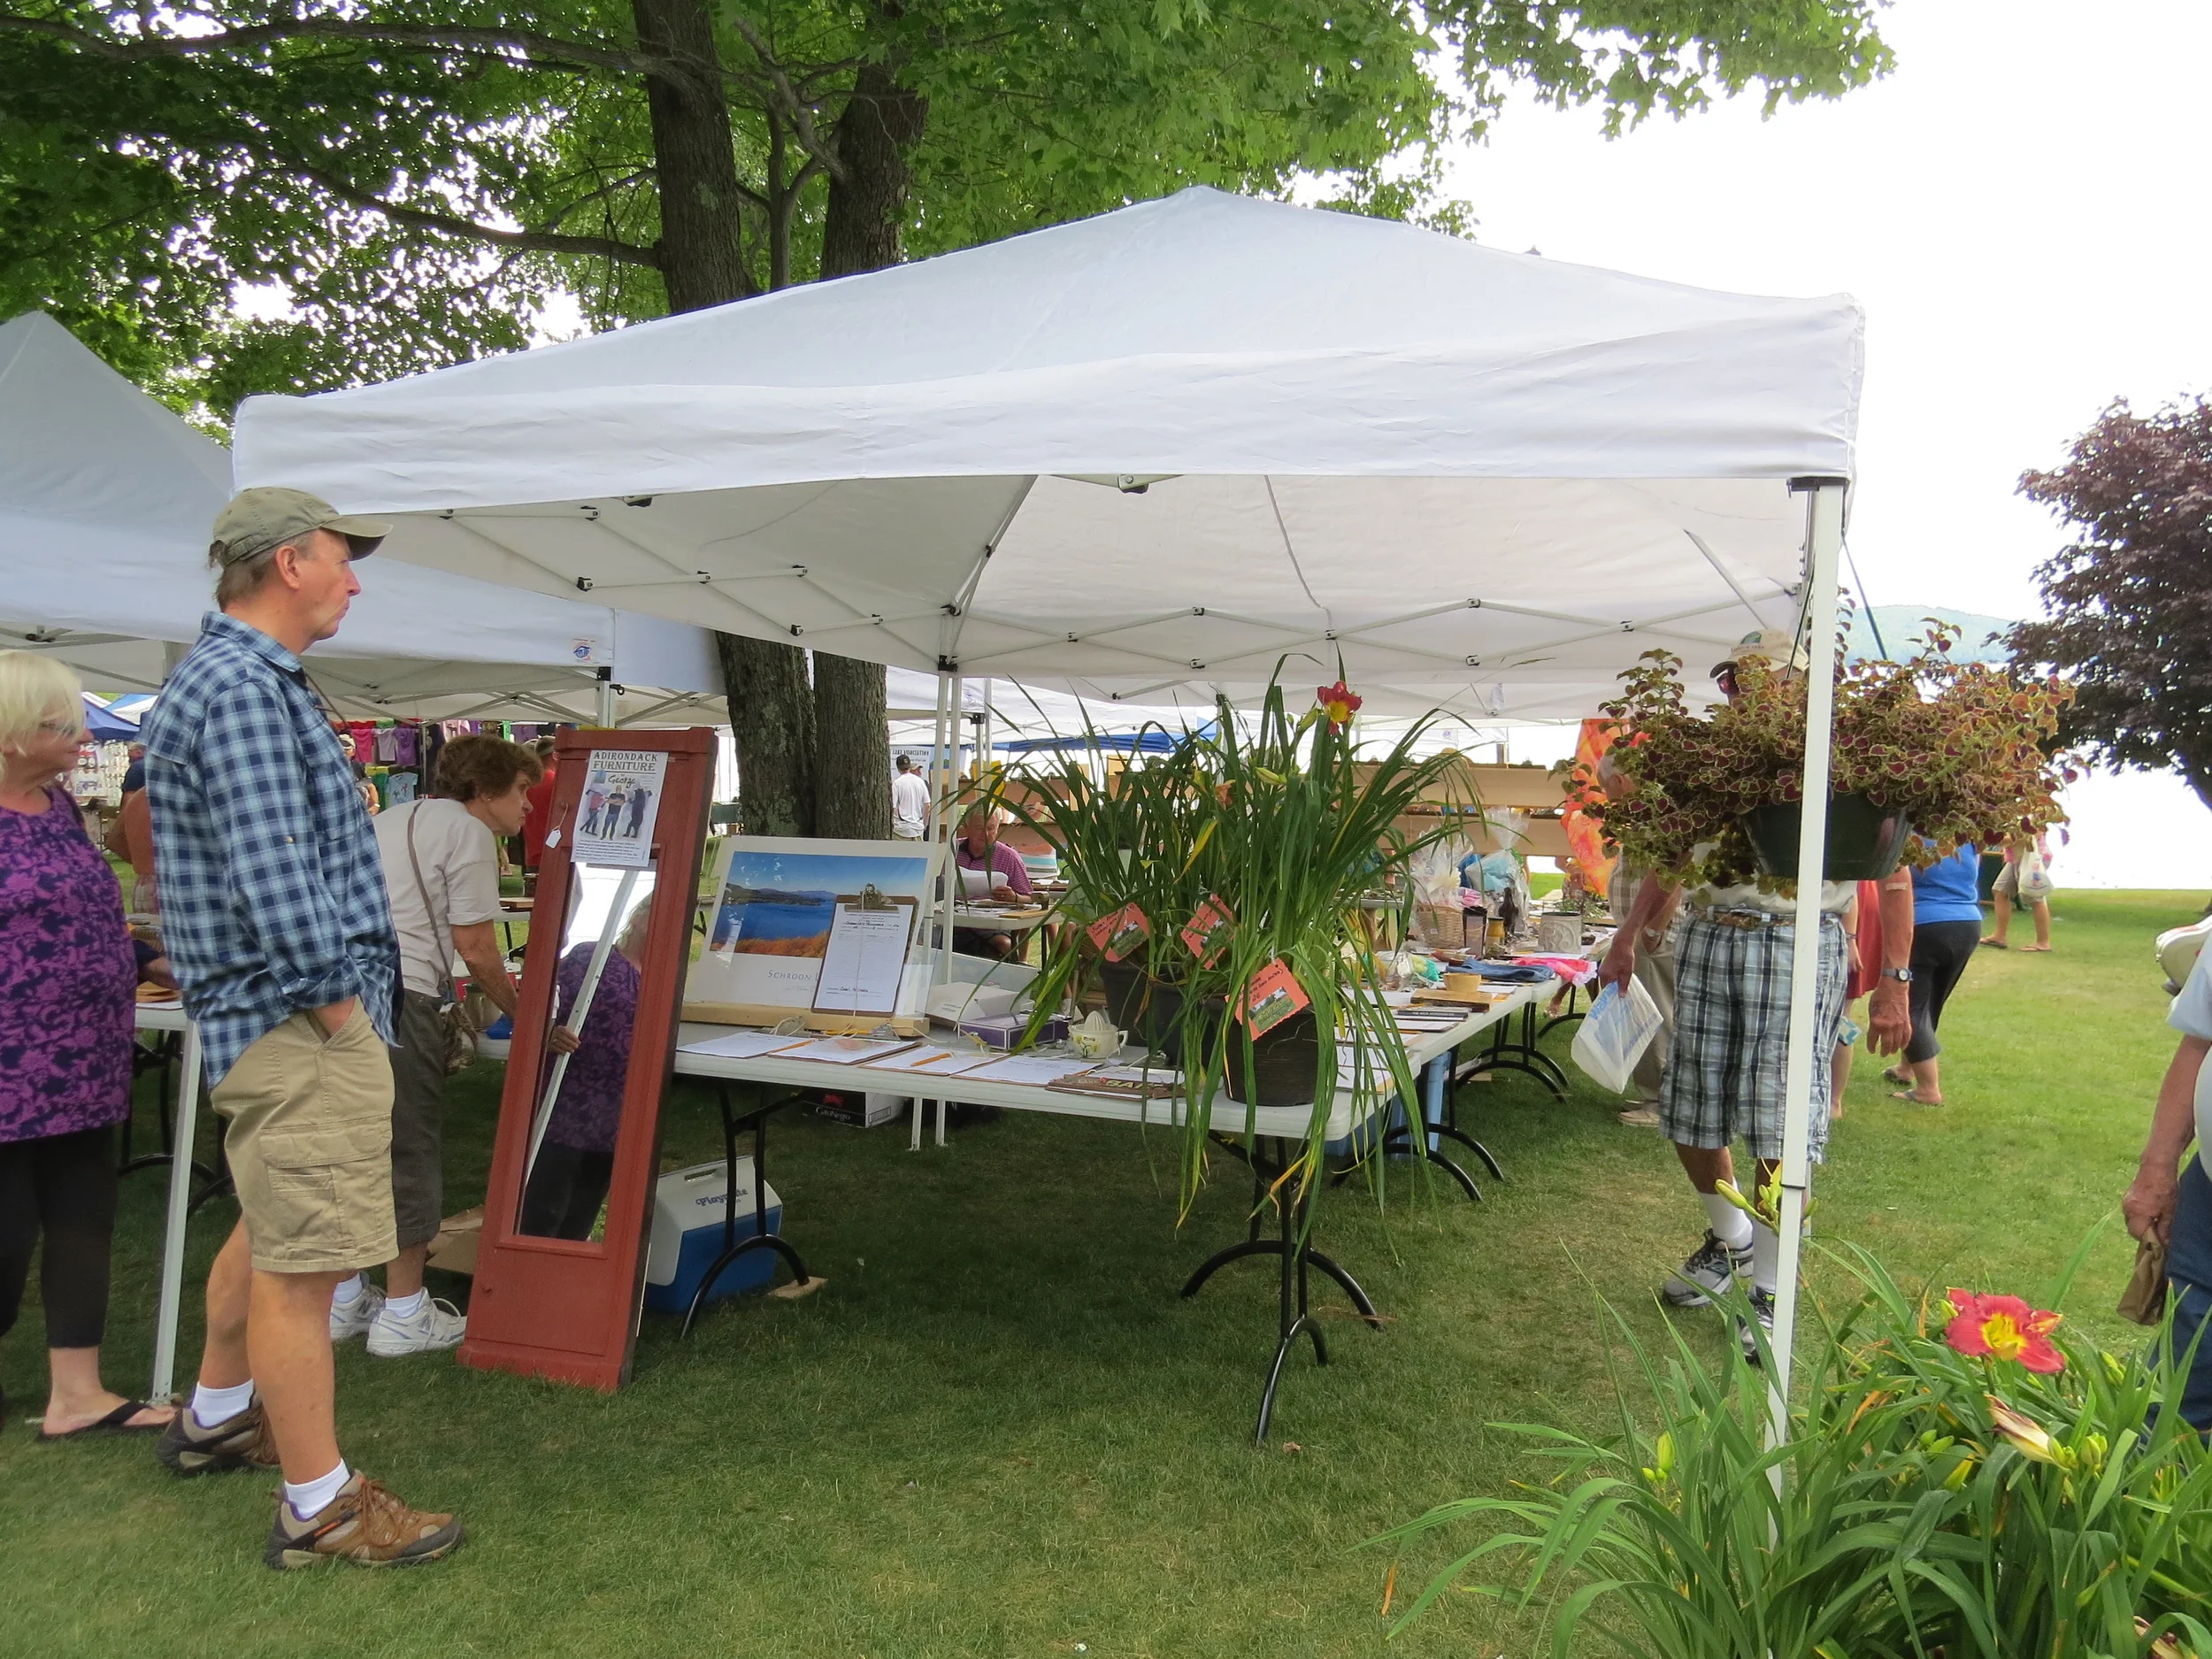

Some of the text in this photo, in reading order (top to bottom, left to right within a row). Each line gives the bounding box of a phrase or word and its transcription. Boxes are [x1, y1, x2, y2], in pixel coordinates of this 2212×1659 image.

[594, 751, 658, 762] ADIRONDACK
[593, 760, 656, 772] FURNITURE
[608, 774, 635, 788] George
[767, 969, 811, 981] SCHROON
[695, 1188, 749, 1206] Playmte
